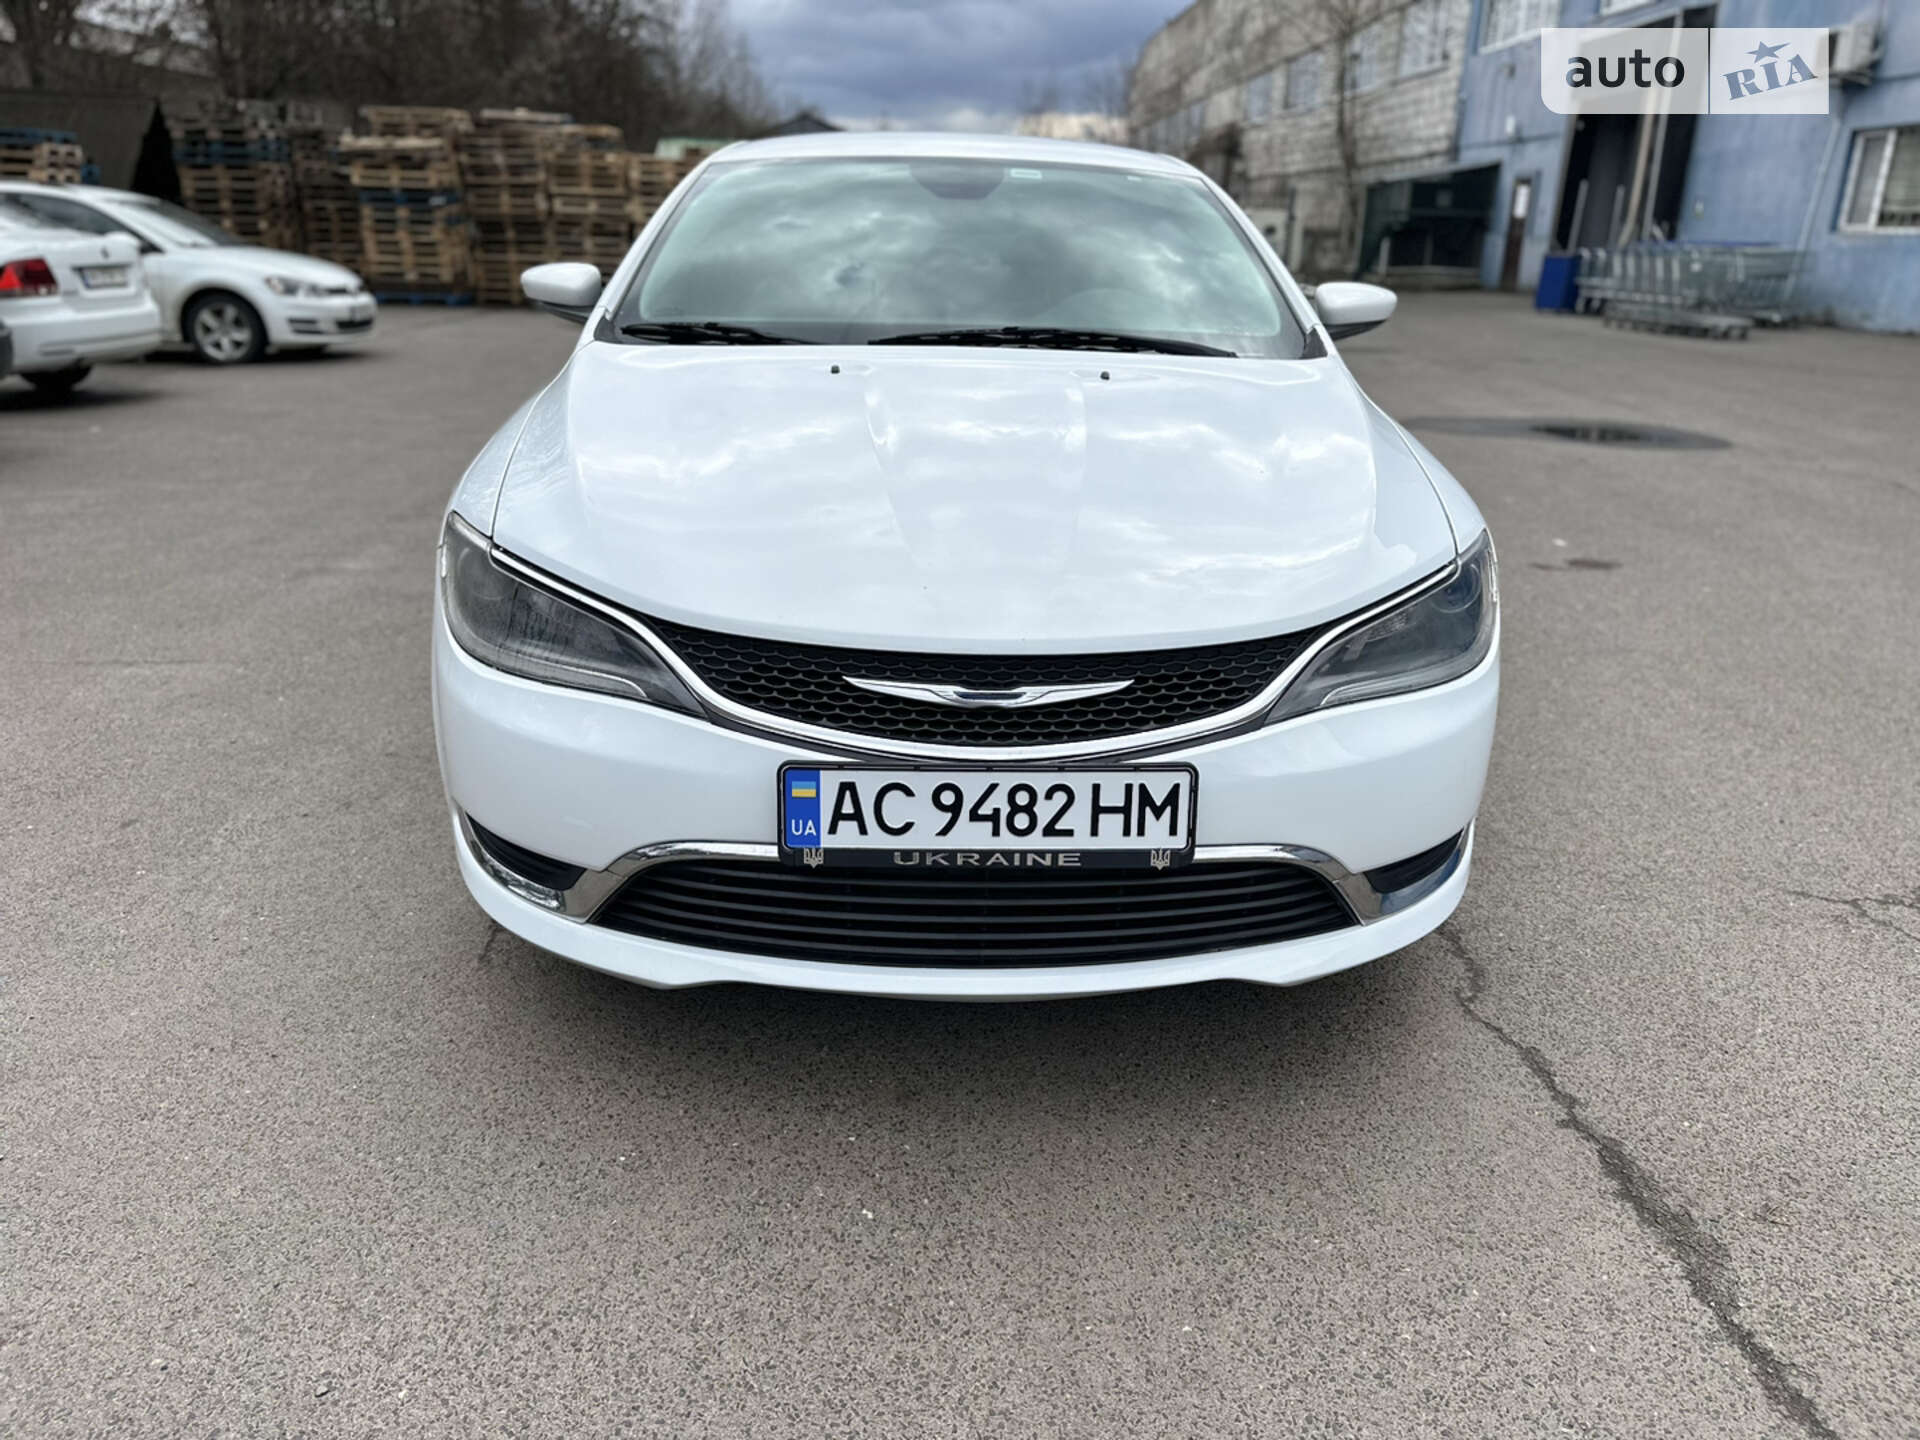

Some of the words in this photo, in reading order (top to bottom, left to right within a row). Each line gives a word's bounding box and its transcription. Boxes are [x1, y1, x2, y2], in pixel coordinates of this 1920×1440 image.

[827, 781, 917, 837] AC
[930, 782, 1077, 838] 9482
[1090, 782, 1181, 838] HM
[791, 818, 817, 837] UA
[893, 851, 1081, 867] UKRAINE
